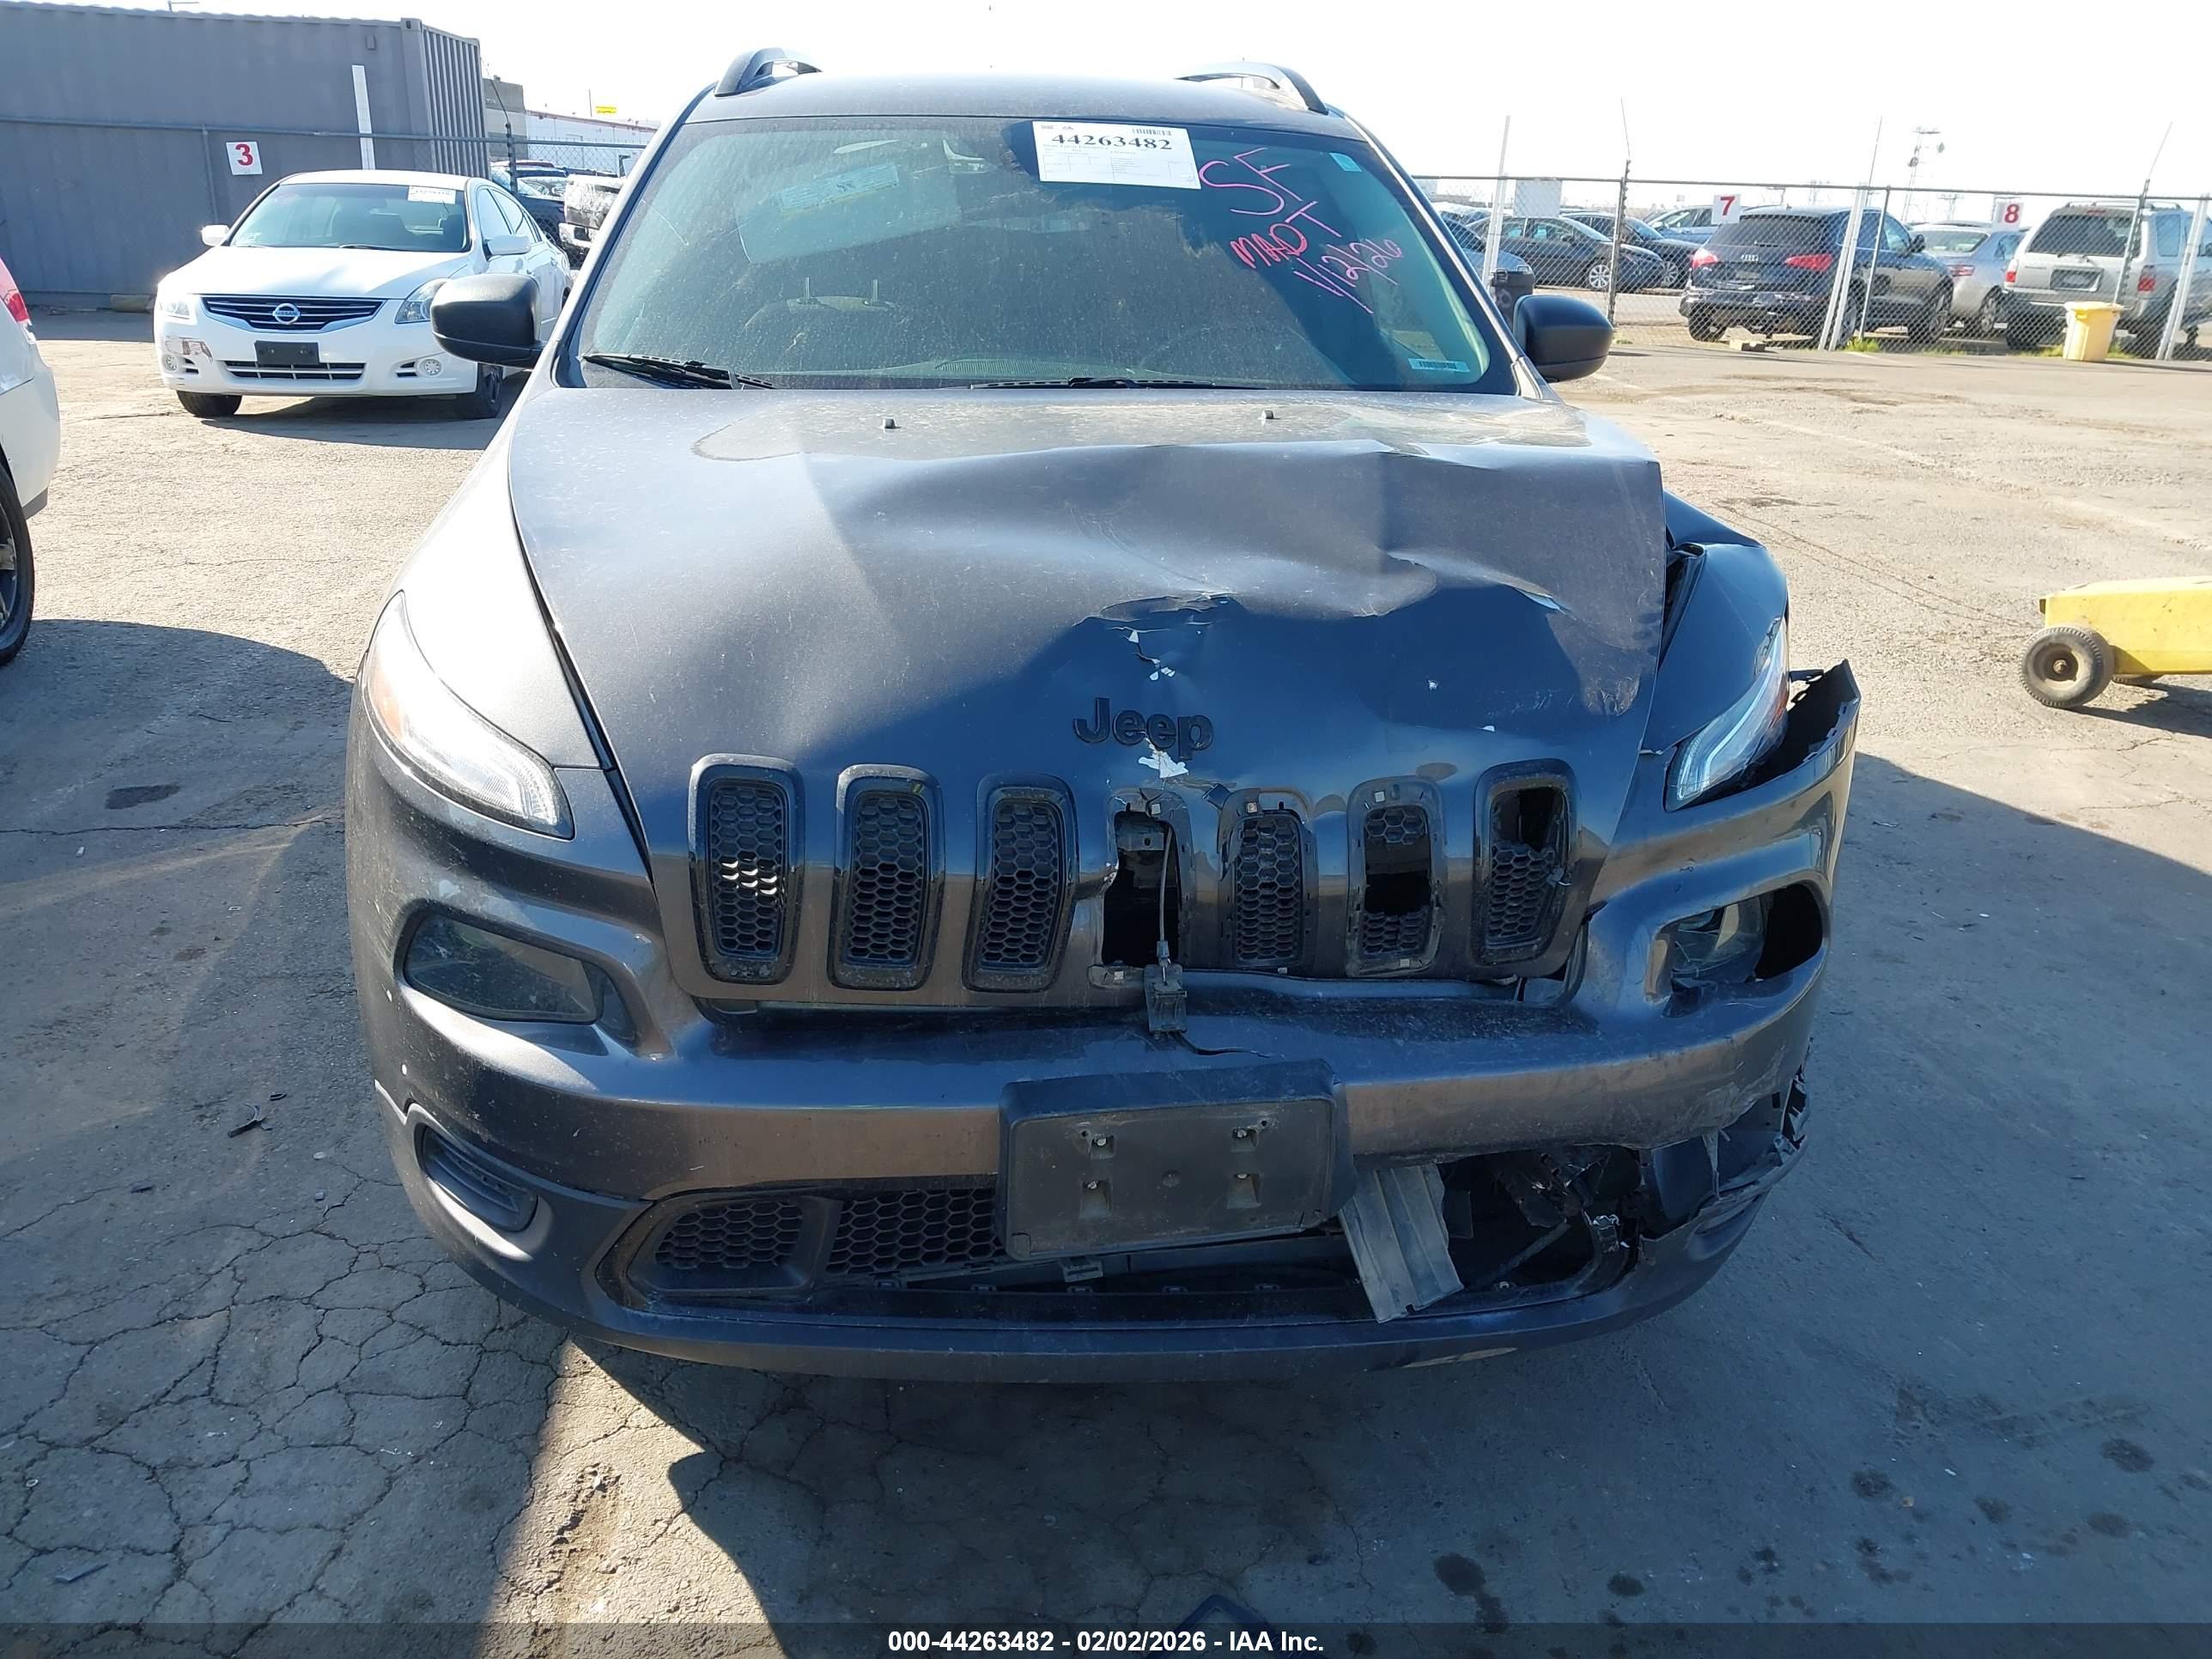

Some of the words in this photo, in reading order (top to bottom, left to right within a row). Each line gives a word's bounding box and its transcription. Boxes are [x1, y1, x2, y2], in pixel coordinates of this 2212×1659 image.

[1051, 134, 1173, 149] 44263482
[235, 143, 253, 166] 3
[1720, 196, 1735, 216] 7
[2004, 204, 2020, 223] 8
[1073, 697, 1213, 761] Jeep
